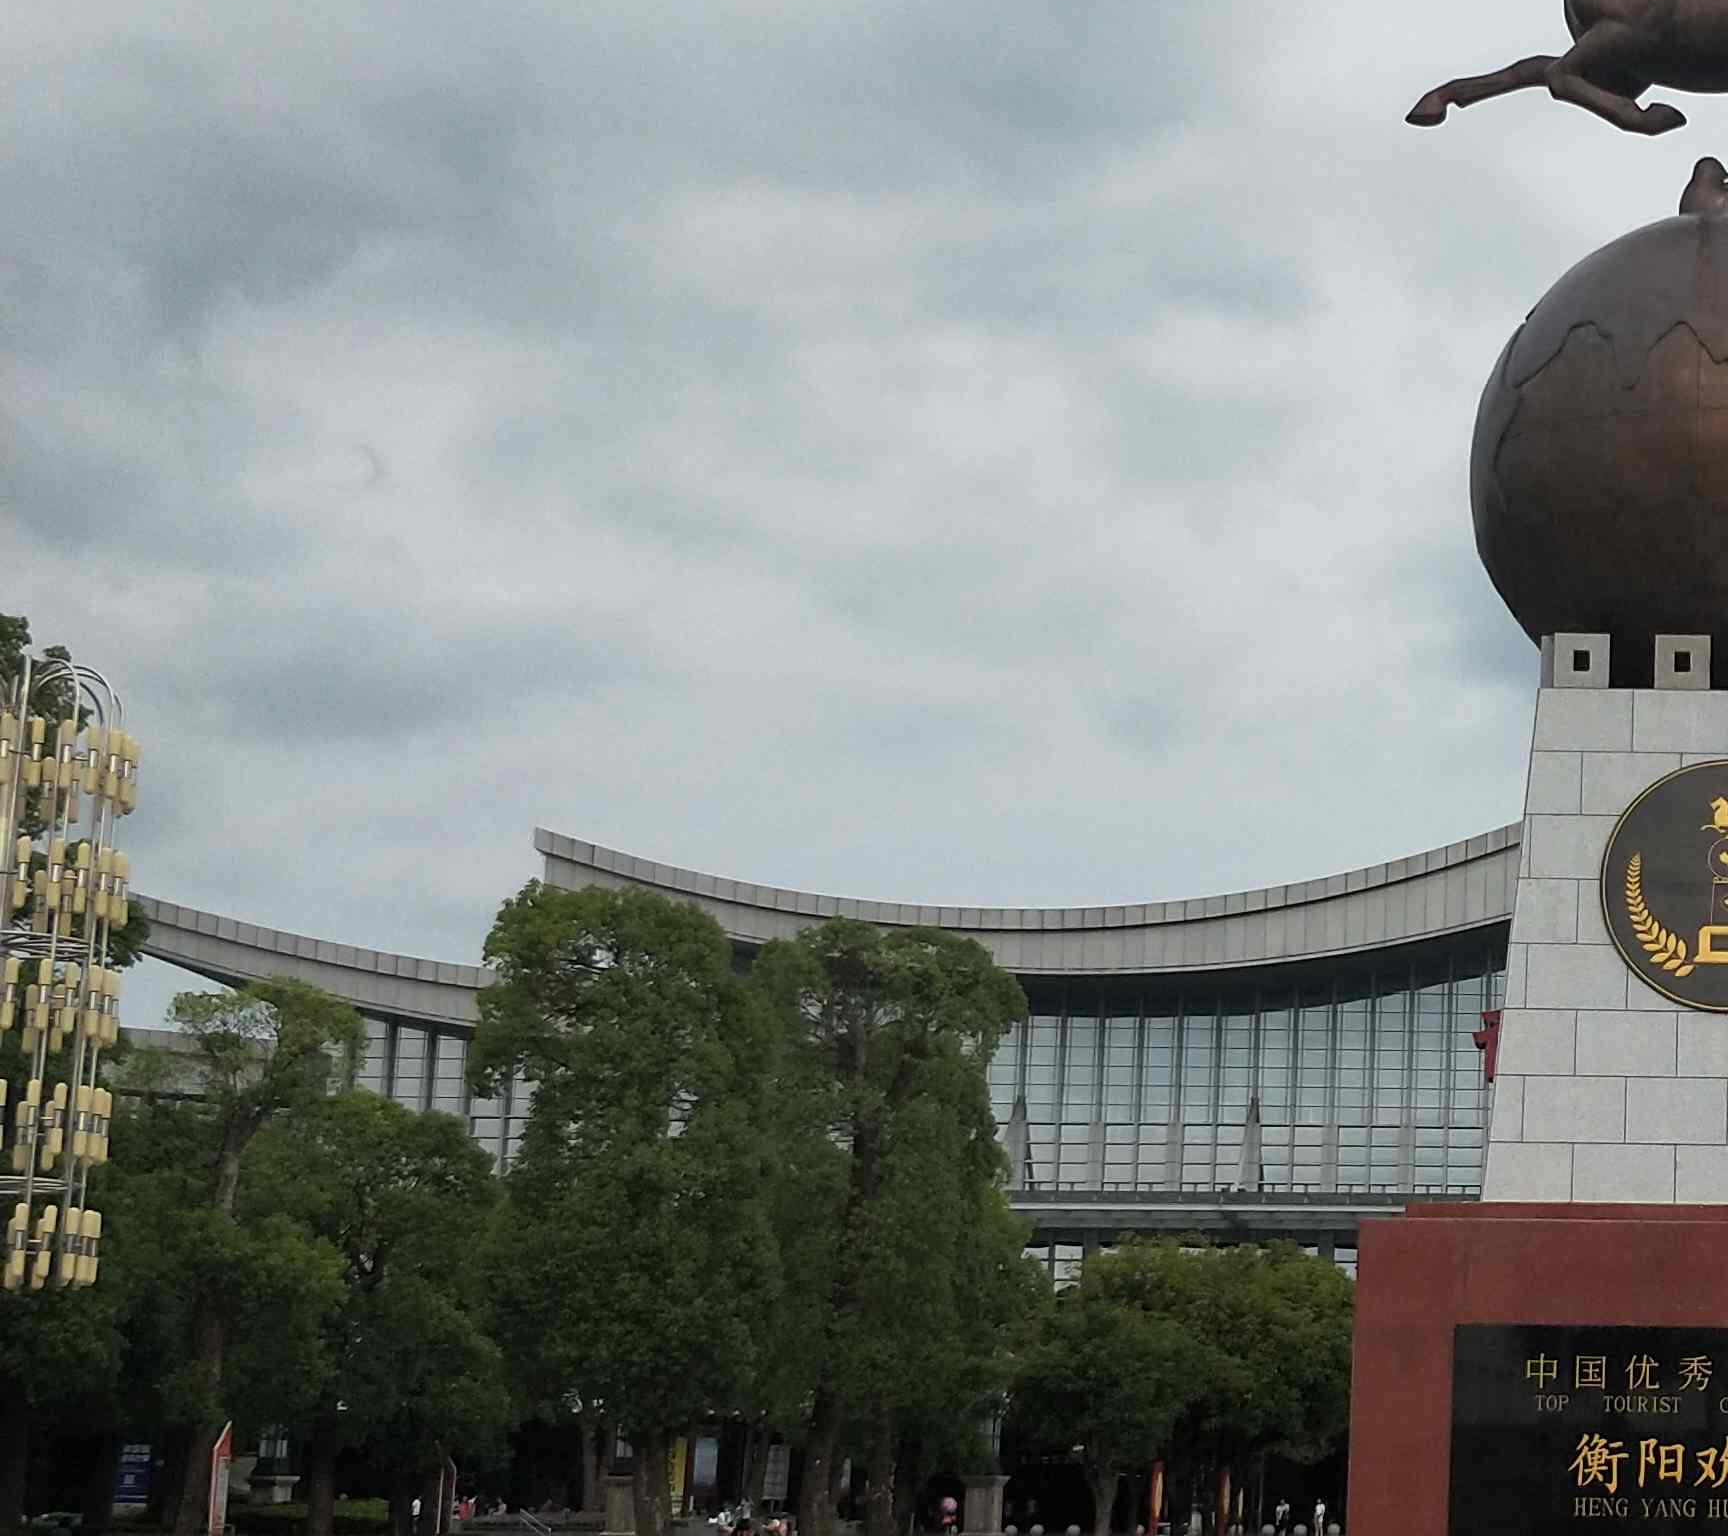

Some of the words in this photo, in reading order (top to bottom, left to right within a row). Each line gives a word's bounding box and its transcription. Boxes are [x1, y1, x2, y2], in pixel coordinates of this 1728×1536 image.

[1535, 1395, 1569, 1412] TOP
[1603, 1395, 1682, 1414] TOURIST
[1573, 1497, 1630, 1517] HENG
[1640, 1498, 1697, 1518] YANG
